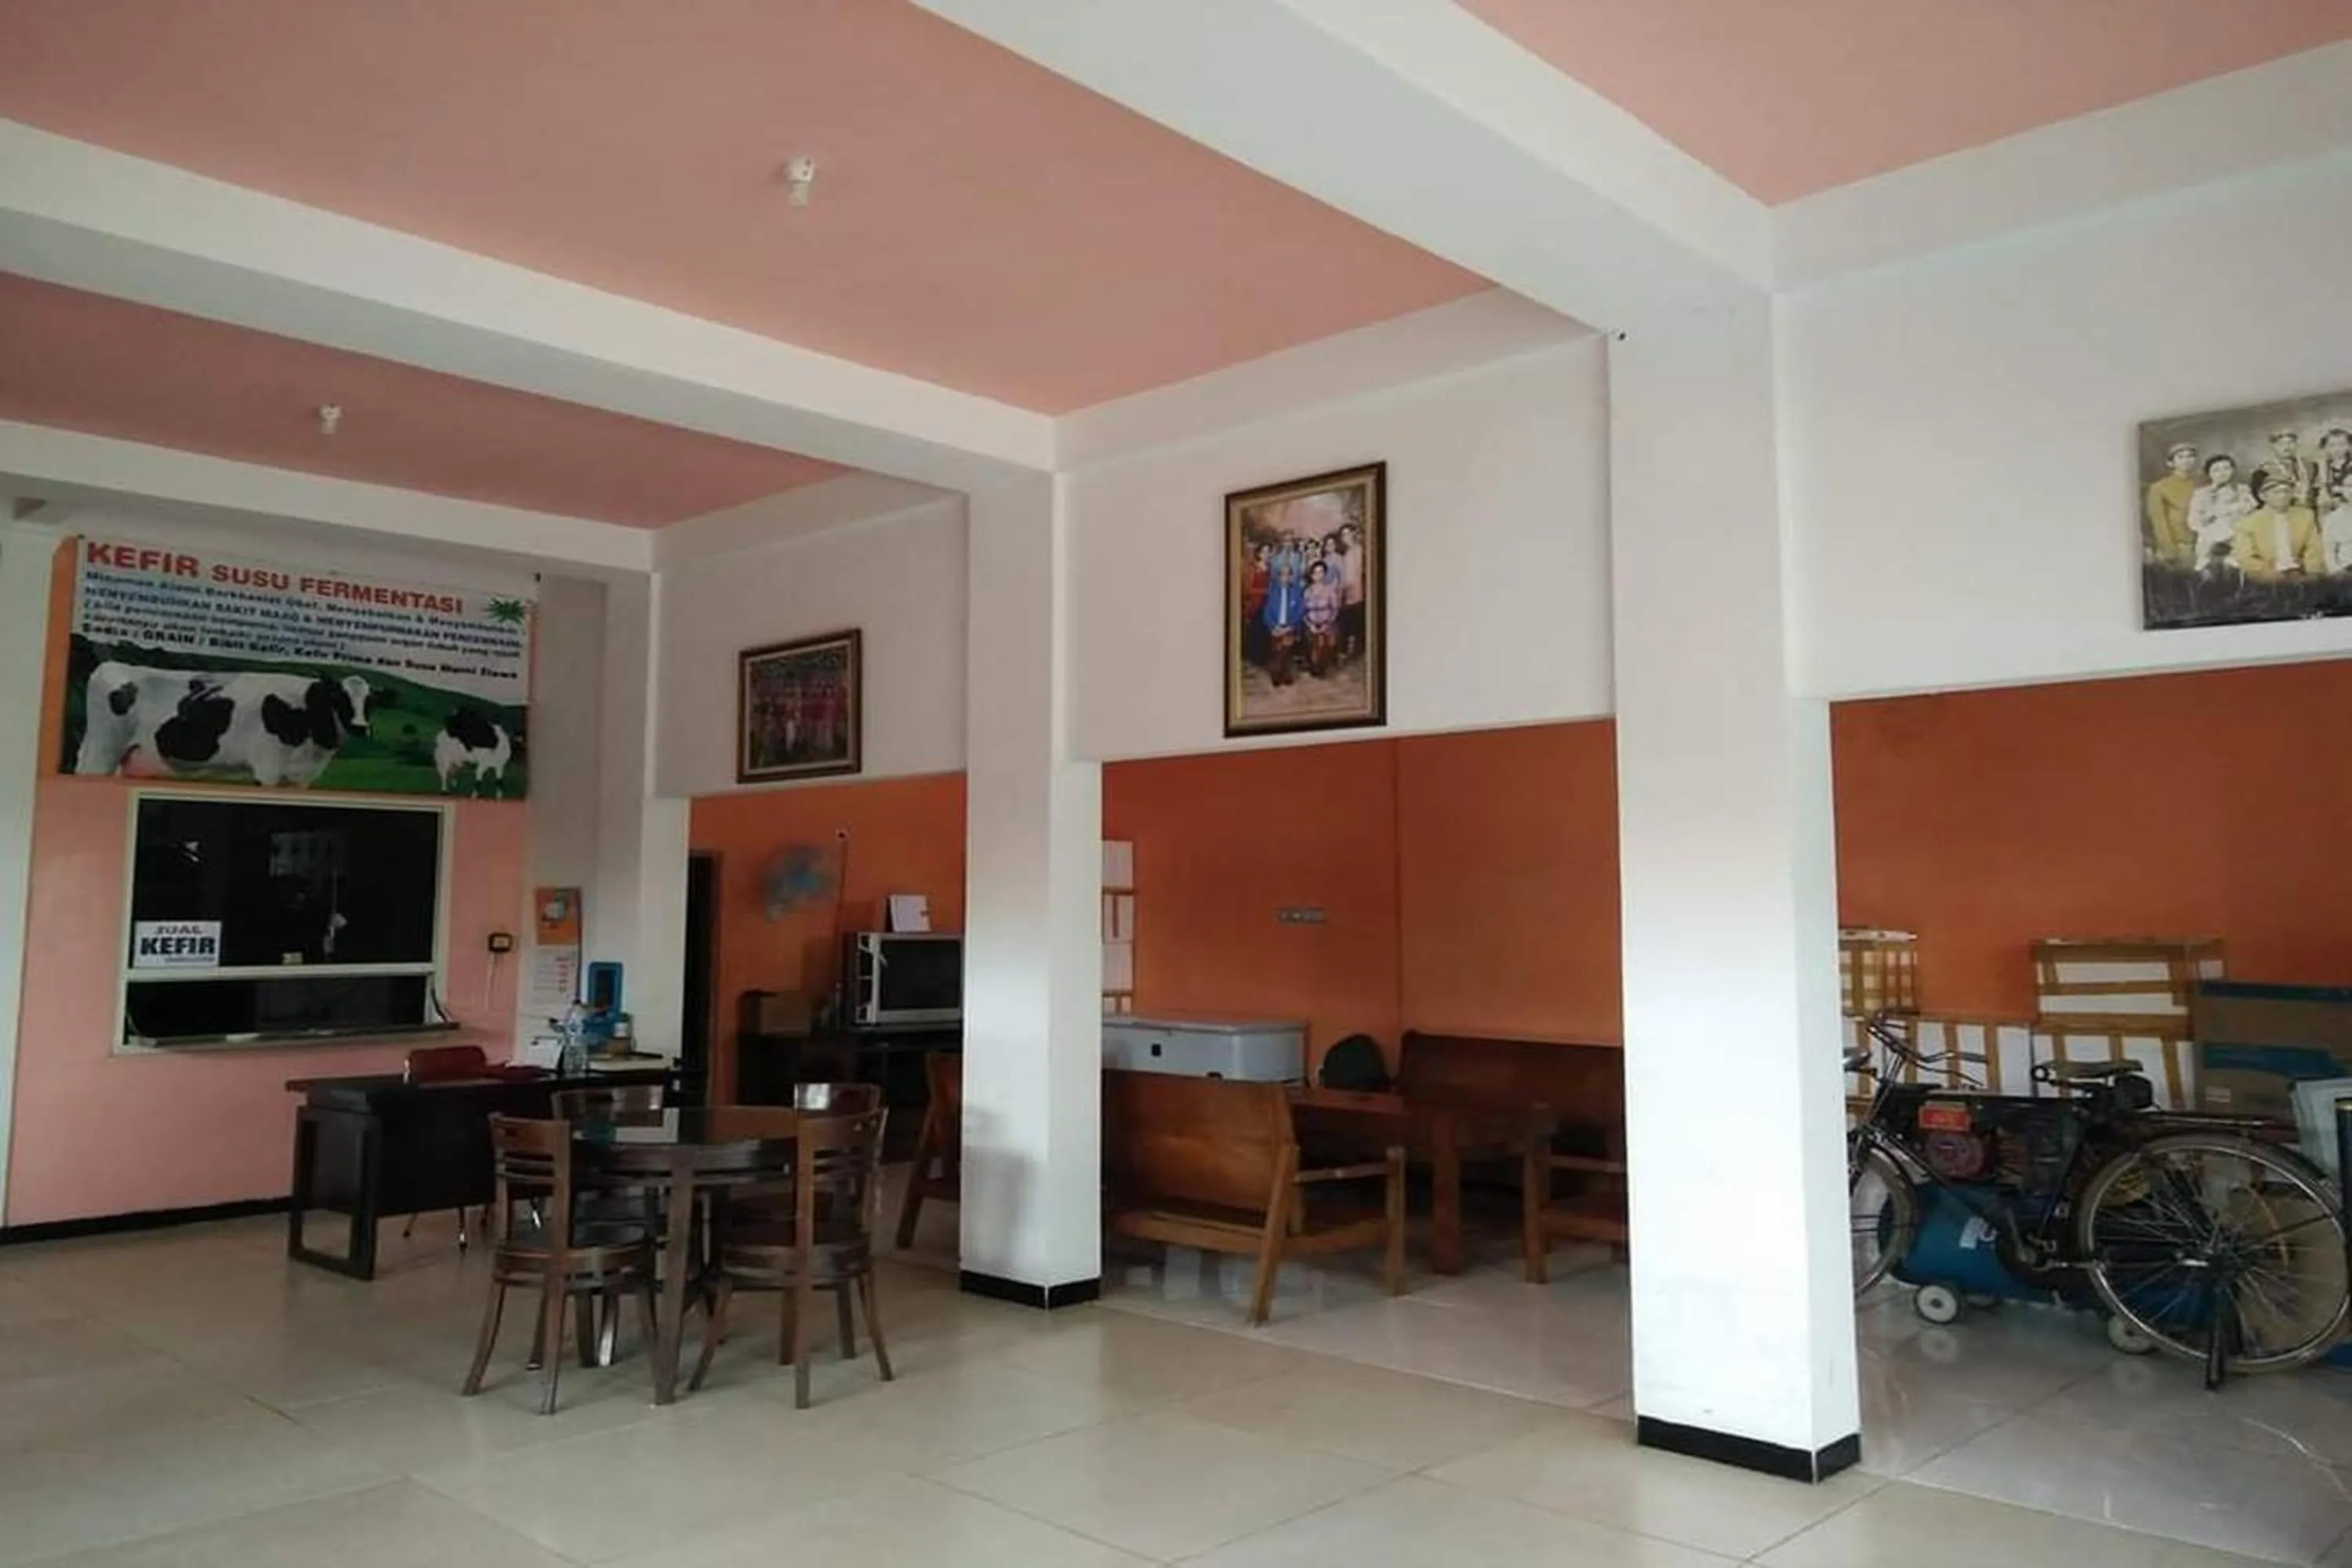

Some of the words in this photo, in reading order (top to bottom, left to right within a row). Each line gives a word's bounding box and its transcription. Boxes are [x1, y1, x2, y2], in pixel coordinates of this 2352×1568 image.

[88, 542, 199, 578] KEFIR
[212, 564, 289, 590] SUSU
[300, 577, 462, 615] FERMENTASI
[143, 629, 195, 644] GRAIN
[158, 925, 202, 935] JUAL
[140, 937, 216, 955] KEFIR
